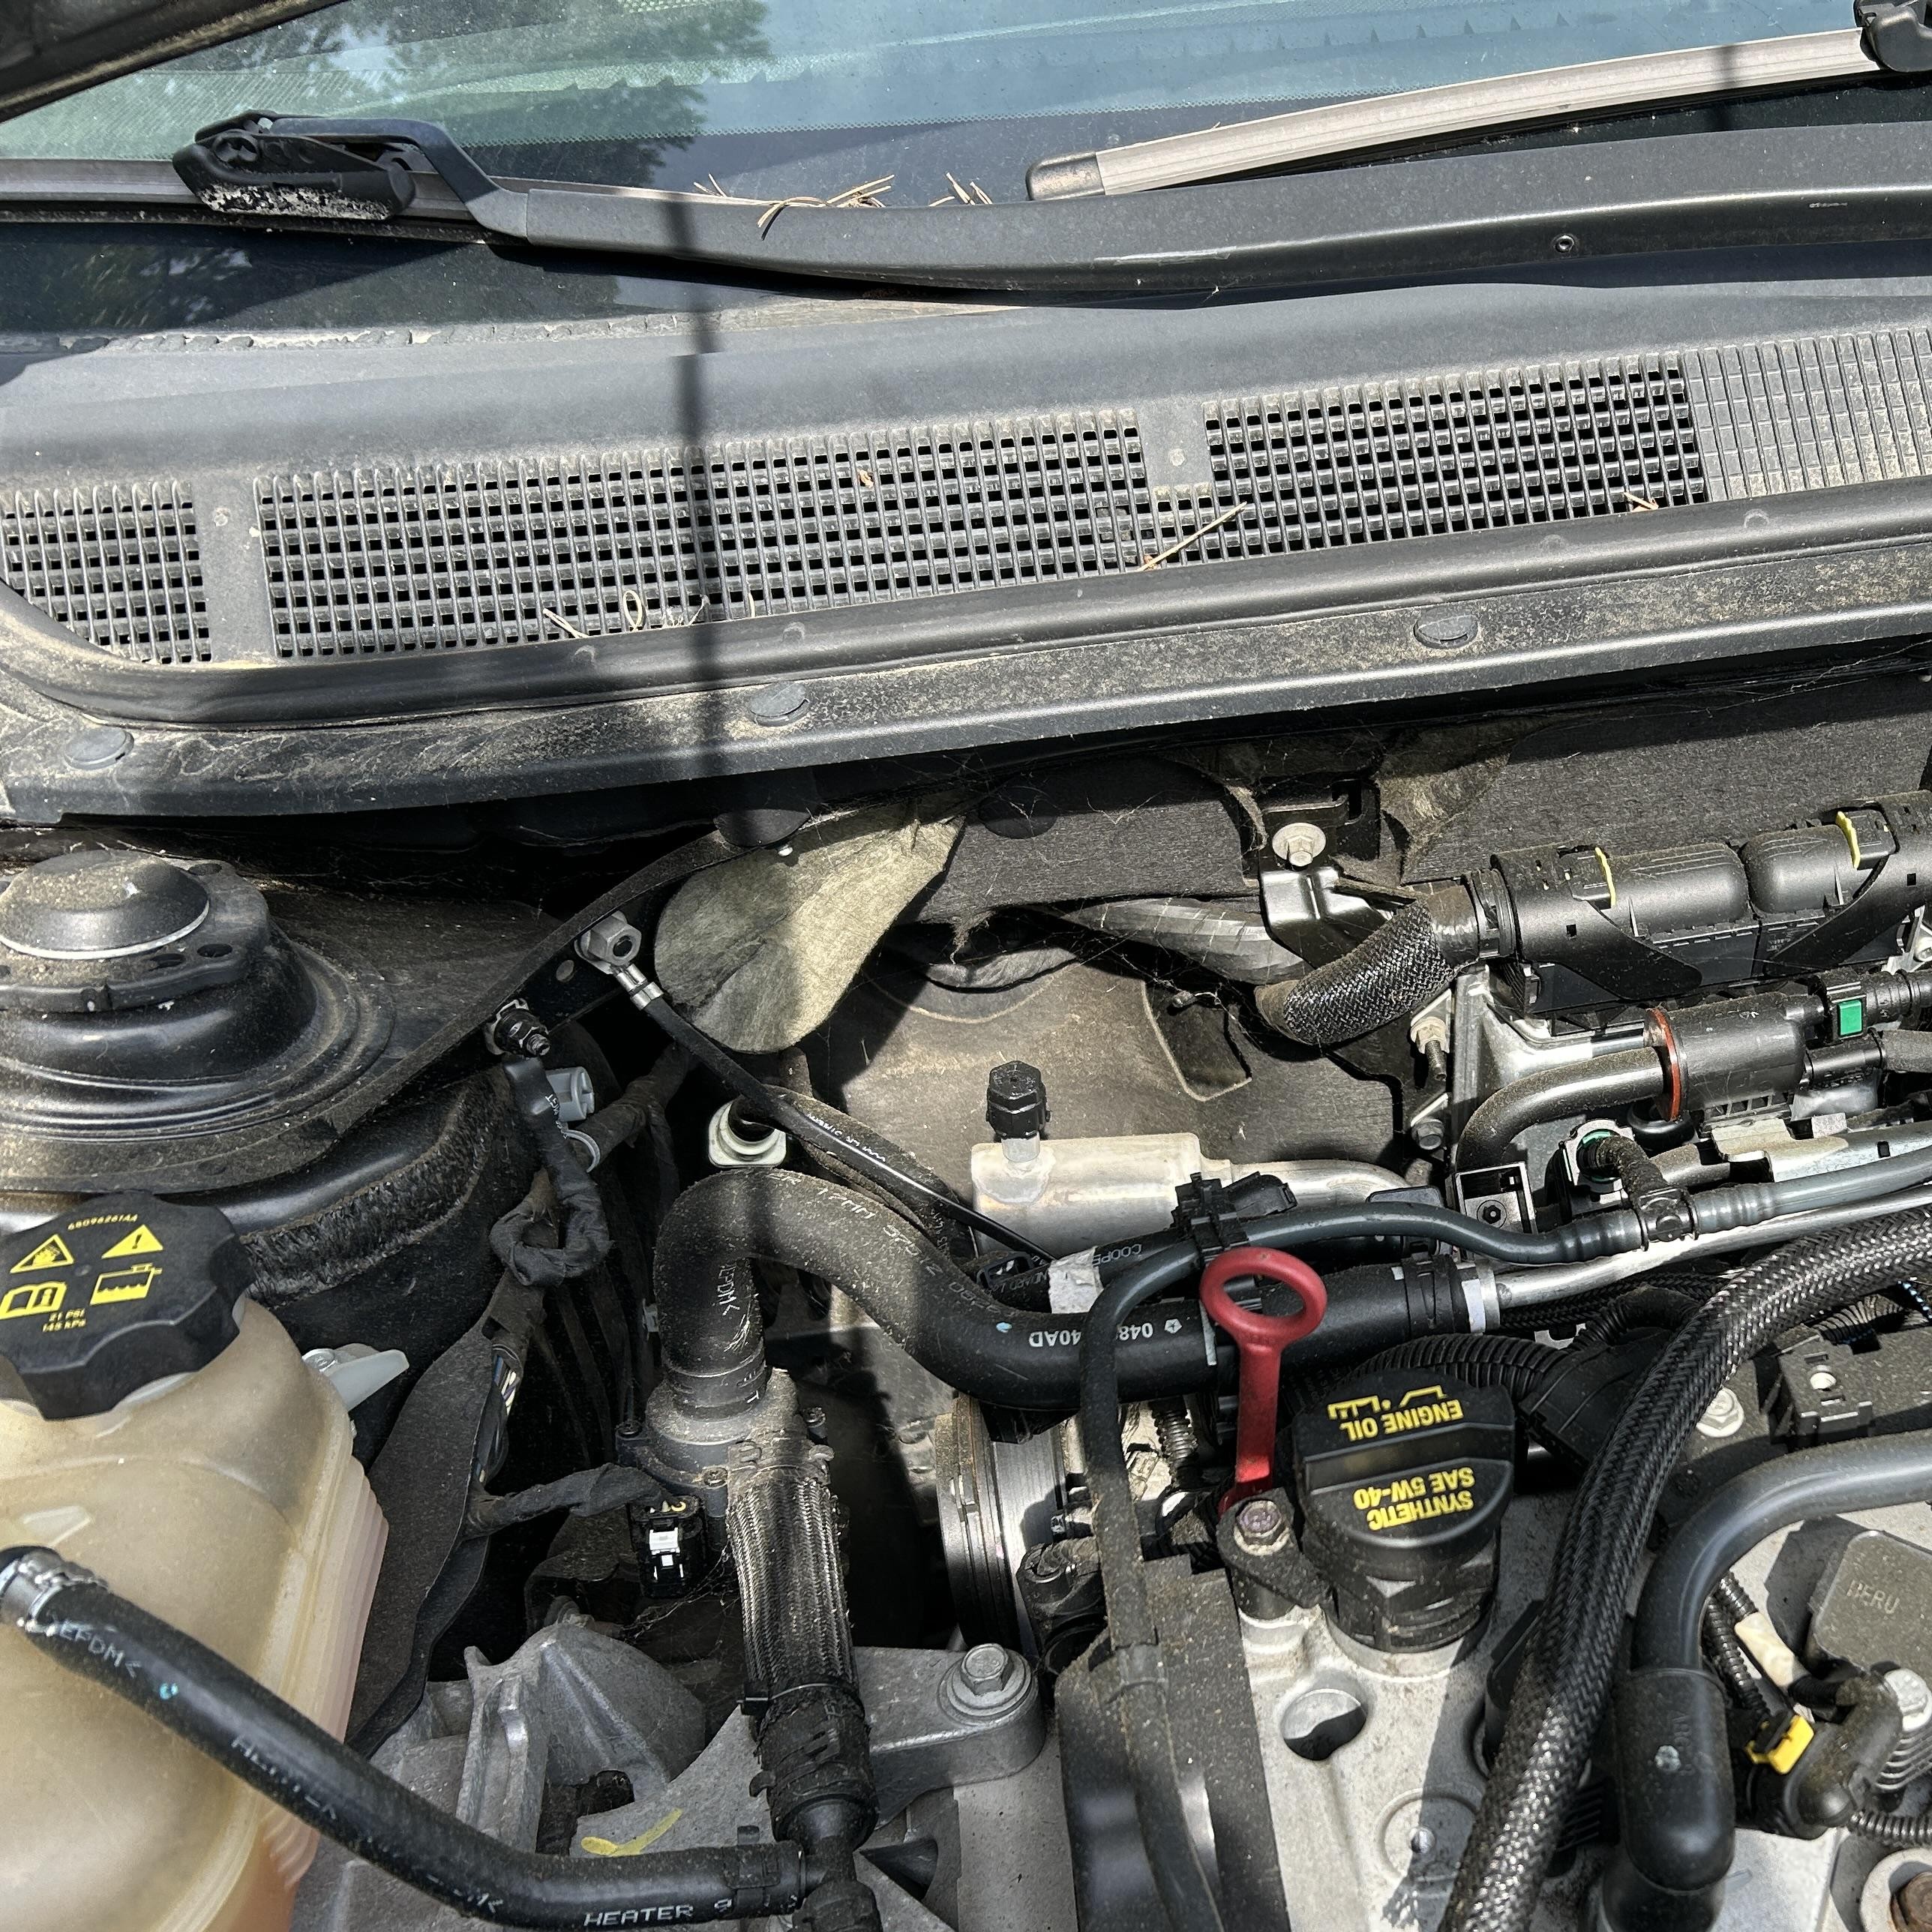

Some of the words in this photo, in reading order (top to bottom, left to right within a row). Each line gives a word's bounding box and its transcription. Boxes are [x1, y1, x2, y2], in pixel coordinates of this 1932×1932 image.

[1340, 1417, 1378, 1442] OIL
[1381, 1399, 1464, 1434] ENGINE
[1353, 1476, 1426, 1510] 5W-40
[1428, 1466, 1475, 1494] SAE
[1366, 1490, 1474, 1531] SYNTHETIC
[584, 1904, 694, 1927] HEATER
